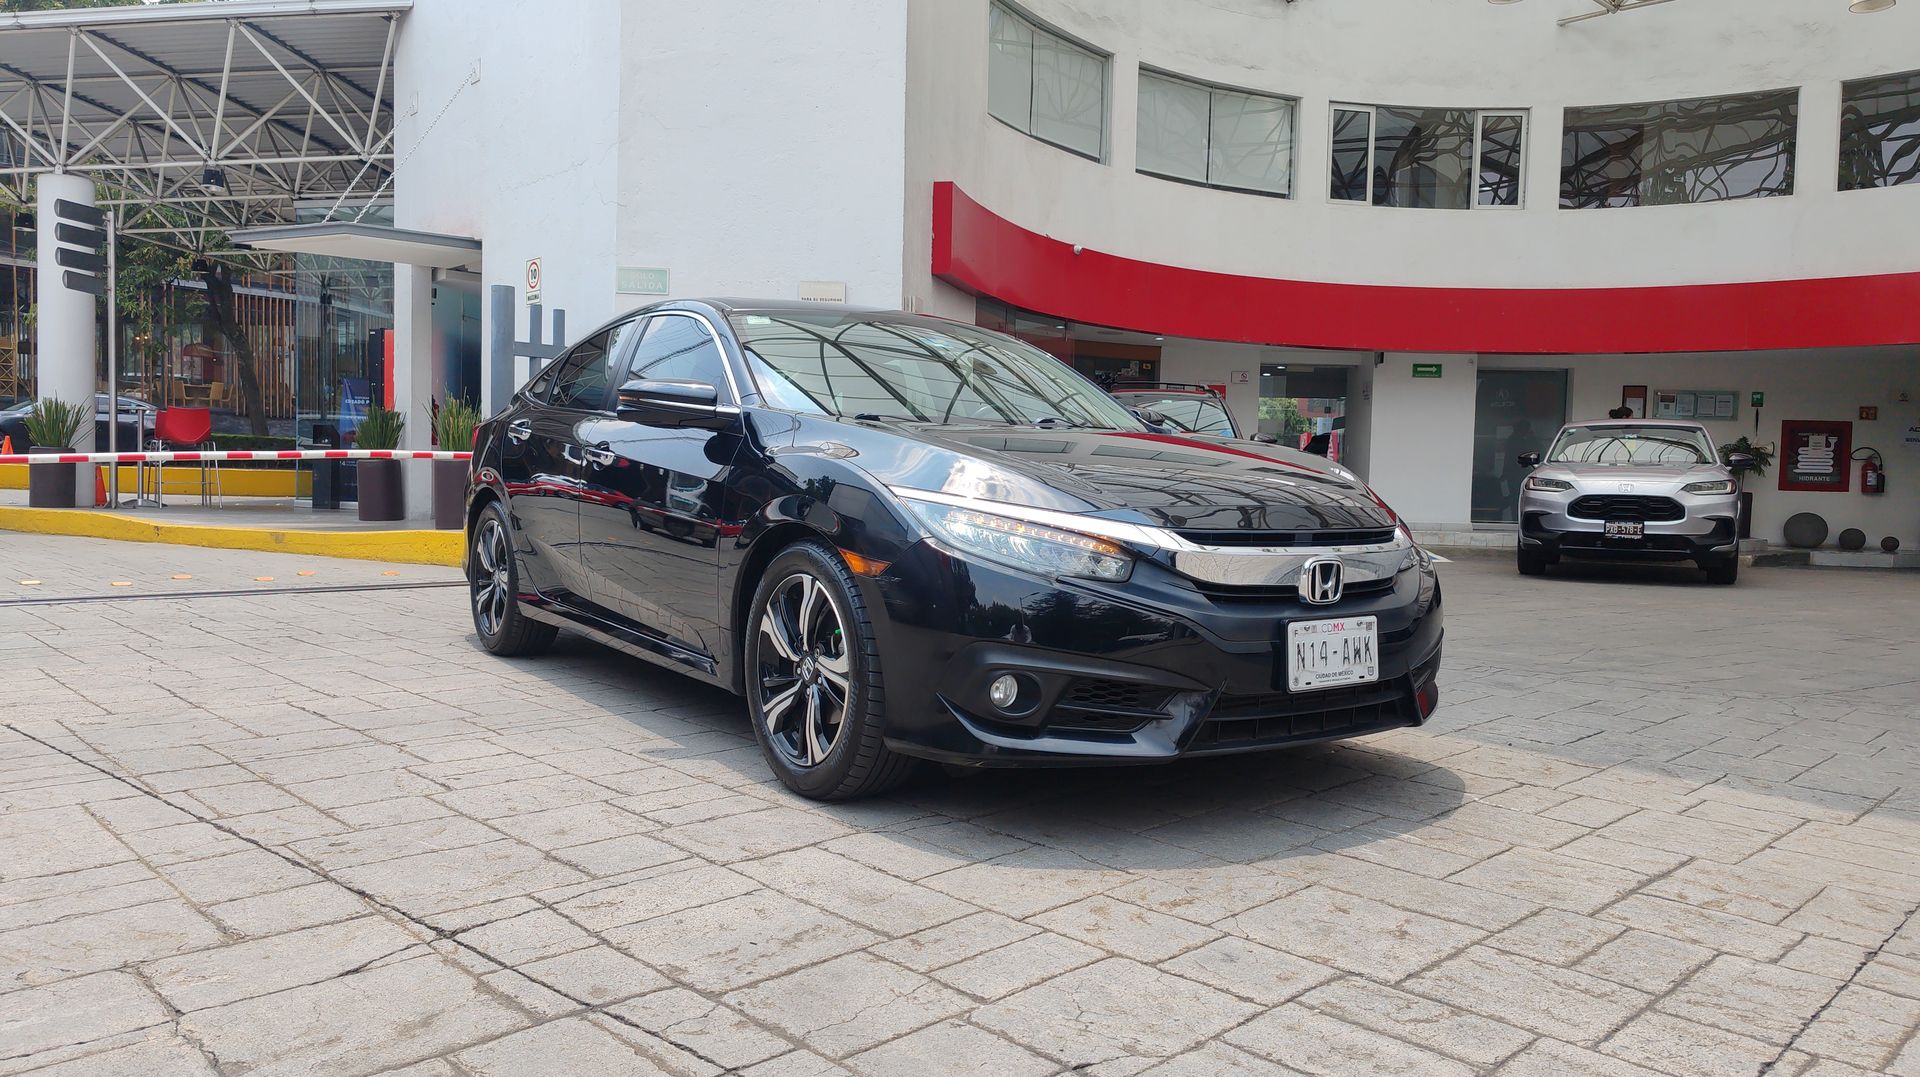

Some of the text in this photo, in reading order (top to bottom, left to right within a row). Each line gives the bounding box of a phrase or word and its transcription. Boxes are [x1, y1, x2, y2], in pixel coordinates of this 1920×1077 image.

[621, 280, 663, 290] SALIDA
[1321, 622, 1345, 633] CDMX
[1297, 636, 1372, 672] N14-AWK
